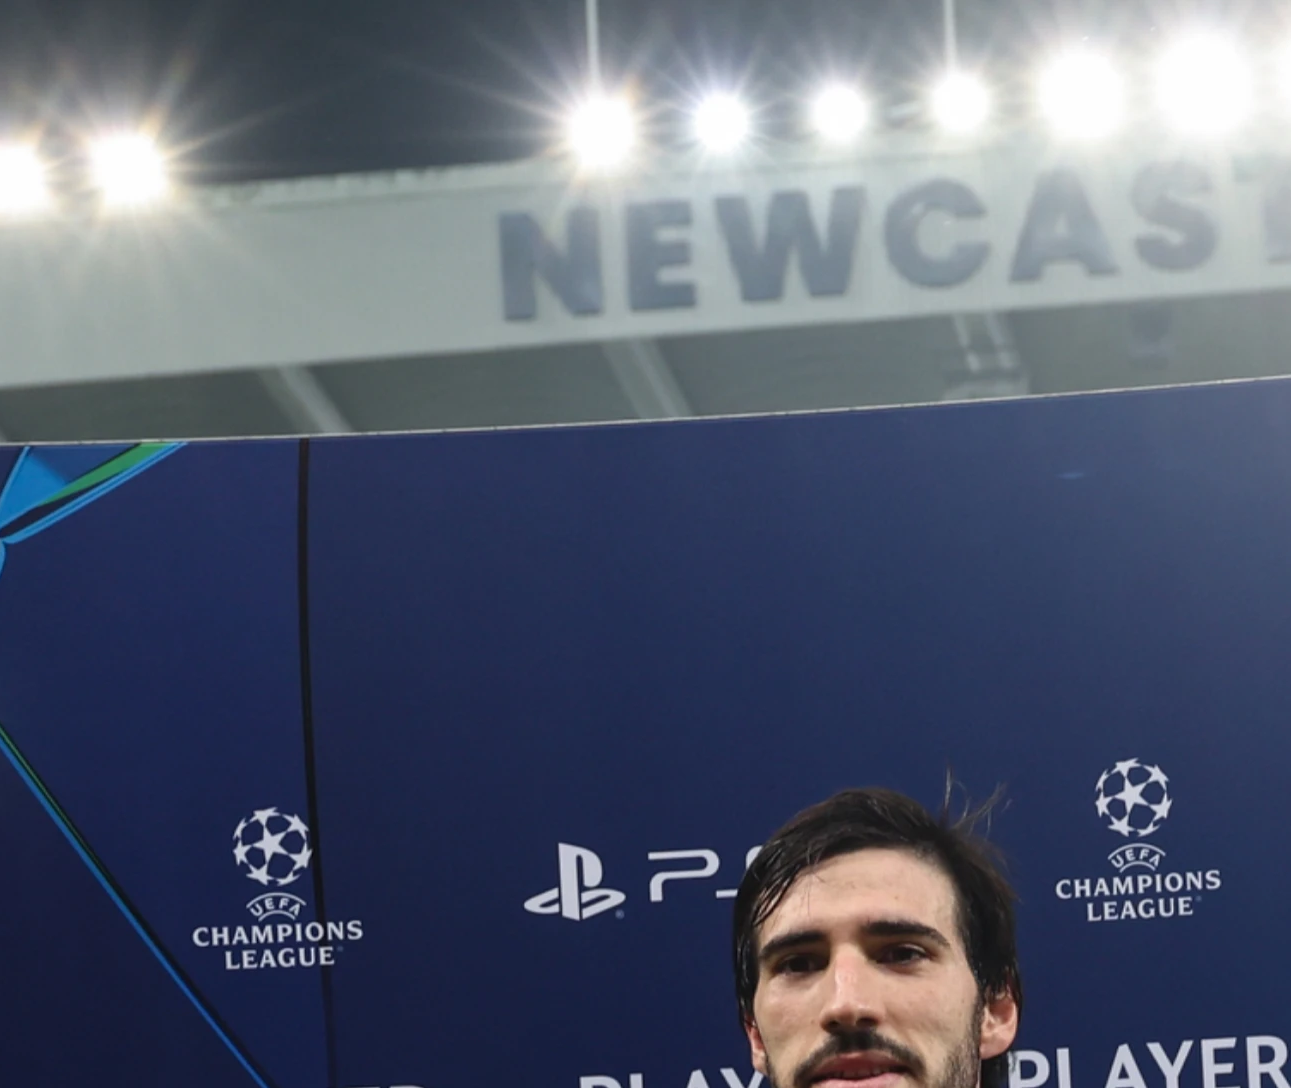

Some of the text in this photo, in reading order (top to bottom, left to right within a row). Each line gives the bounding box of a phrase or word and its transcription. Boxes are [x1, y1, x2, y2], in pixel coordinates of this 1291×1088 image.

[1111, 848, 1160, 869] UEFA
[1055, 869, 1222, 900] CHAMPIONS
[250, 898, 301, 917] UEFA
[1087, 896, 1194, 922] LEAGUE
[192, 920, 364, 947] CHAMPIONS
[225, 946, 336, 970] LEAGUE
